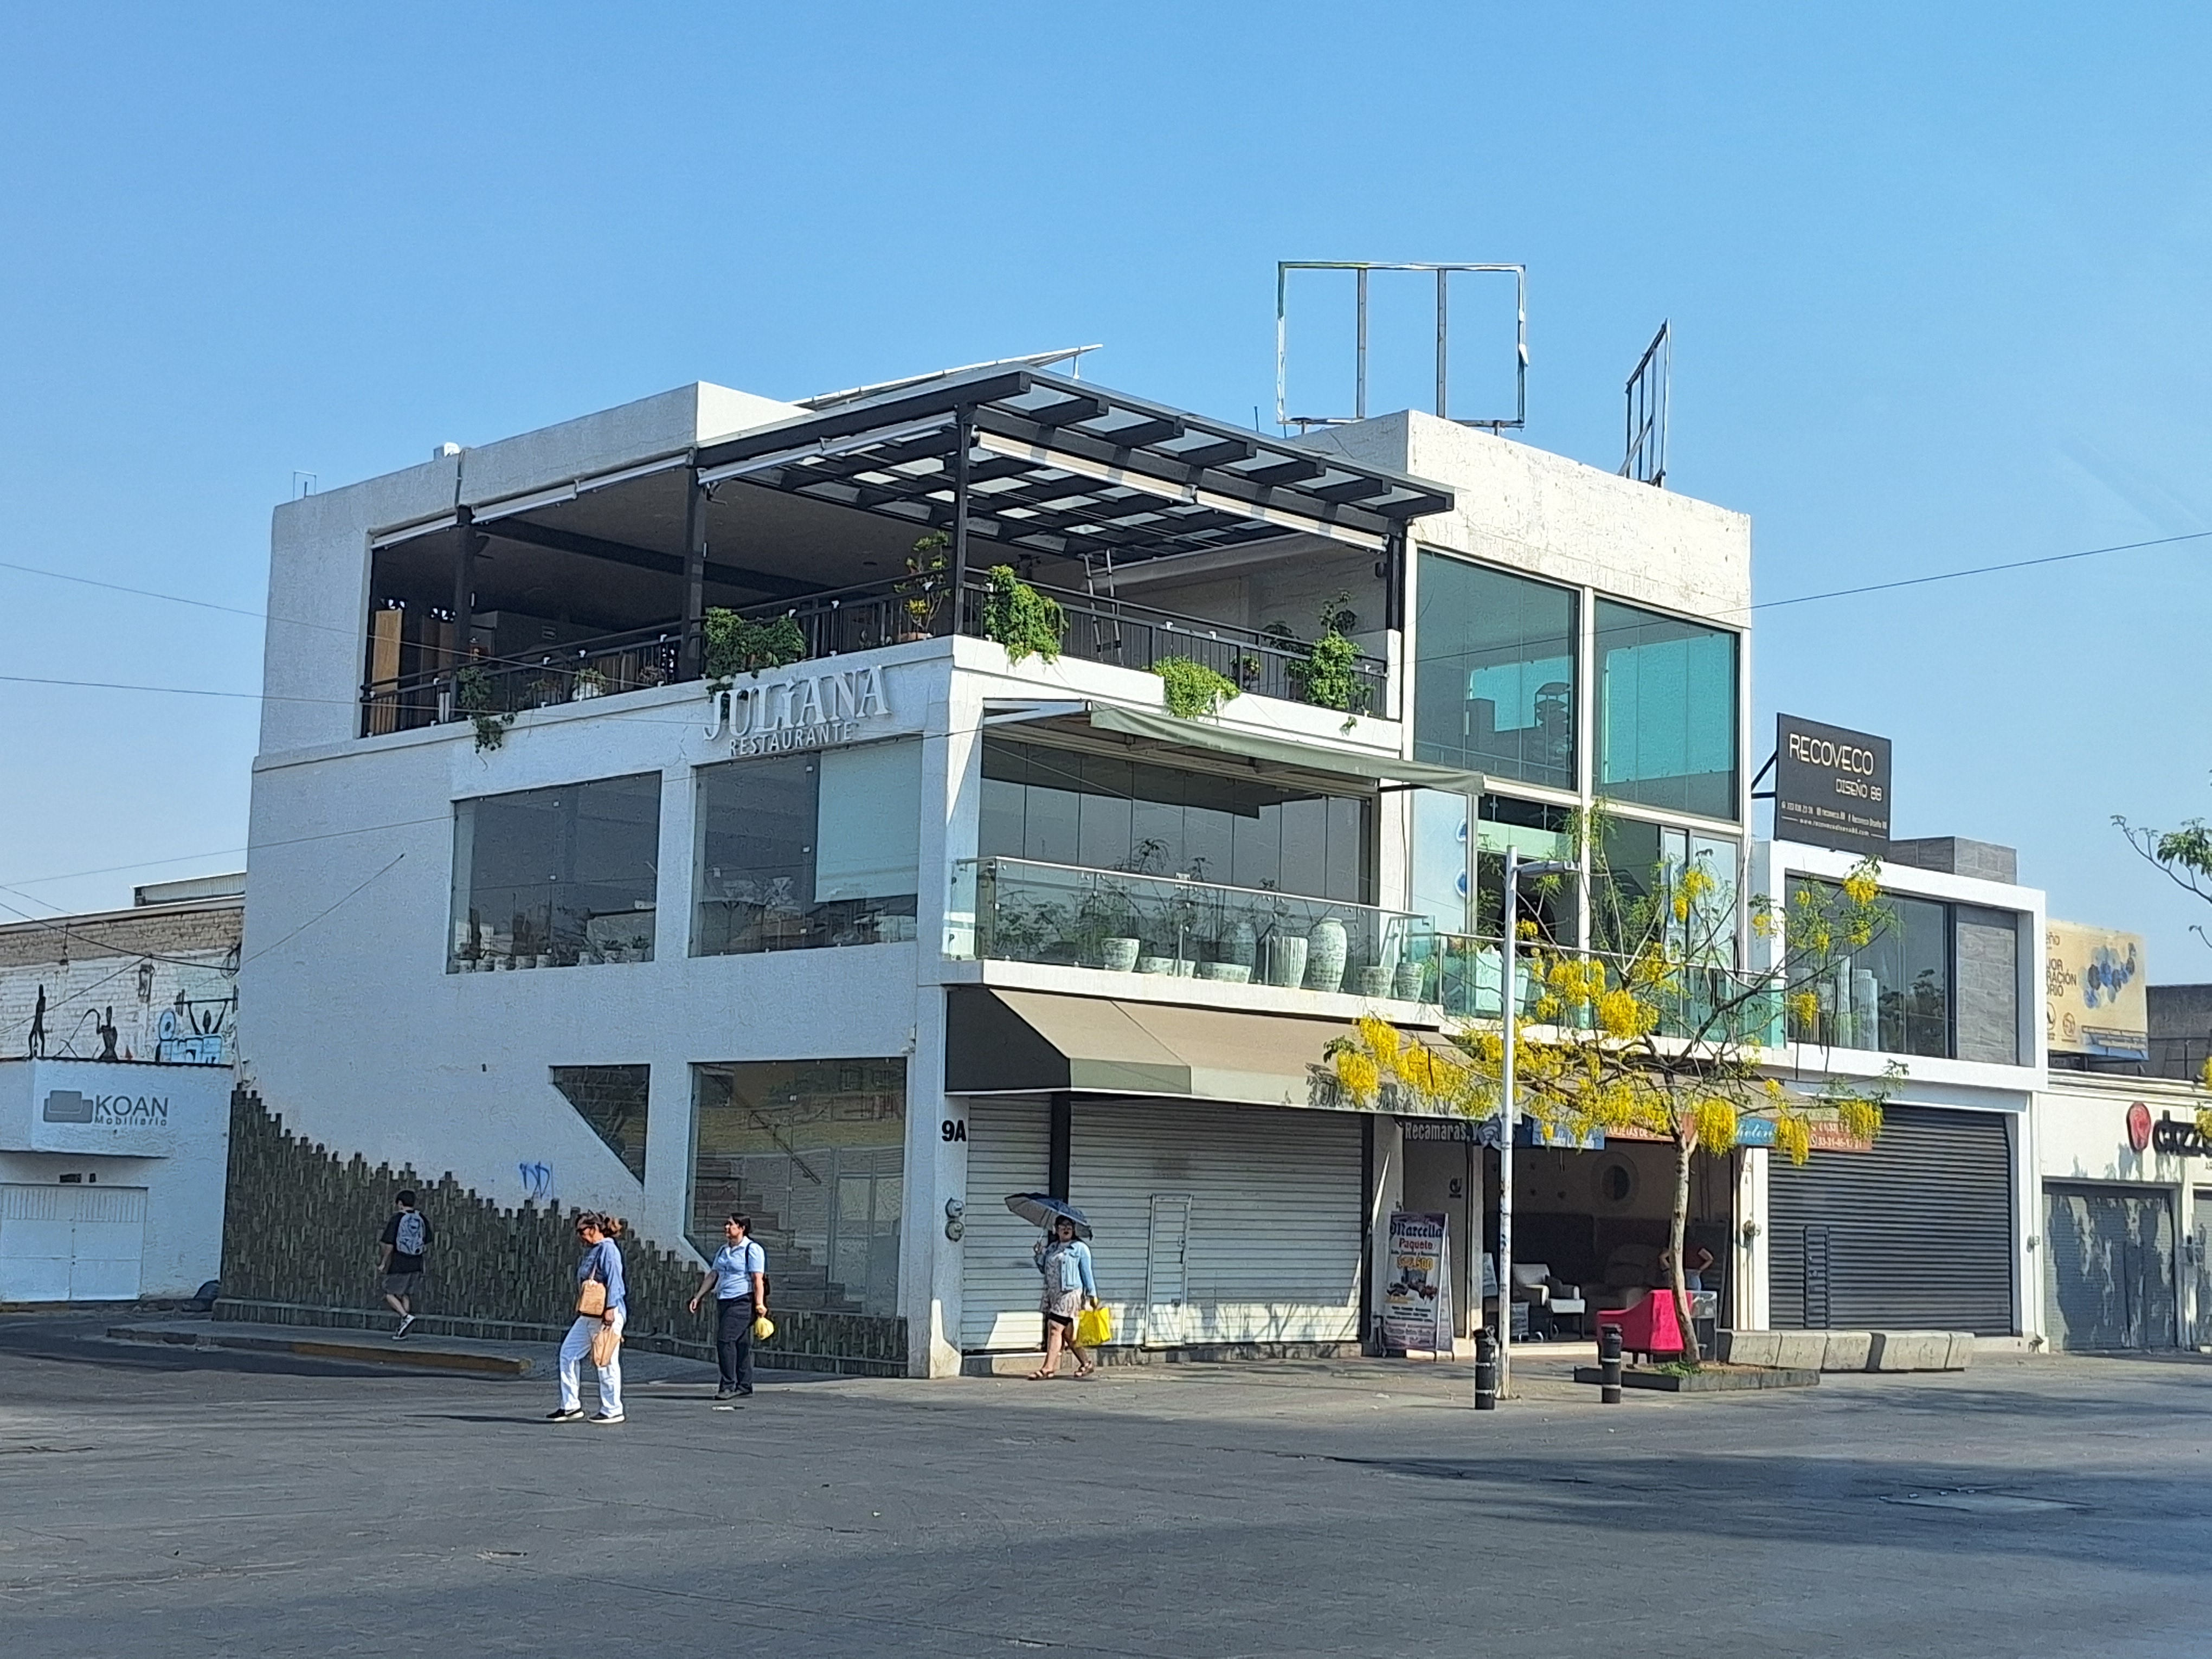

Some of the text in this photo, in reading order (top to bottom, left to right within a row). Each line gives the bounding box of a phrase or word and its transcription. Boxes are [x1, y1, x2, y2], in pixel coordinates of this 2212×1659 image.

[729, 722, 853, 756] RESTAURANTE
[1789, 732, 1874, 775] RECOVECO
[95, 1095, 169, 1117] KOAN
[94, 1115, 167, 1126] Mobiliario
[942, 1120, 967, 1142] 9A
